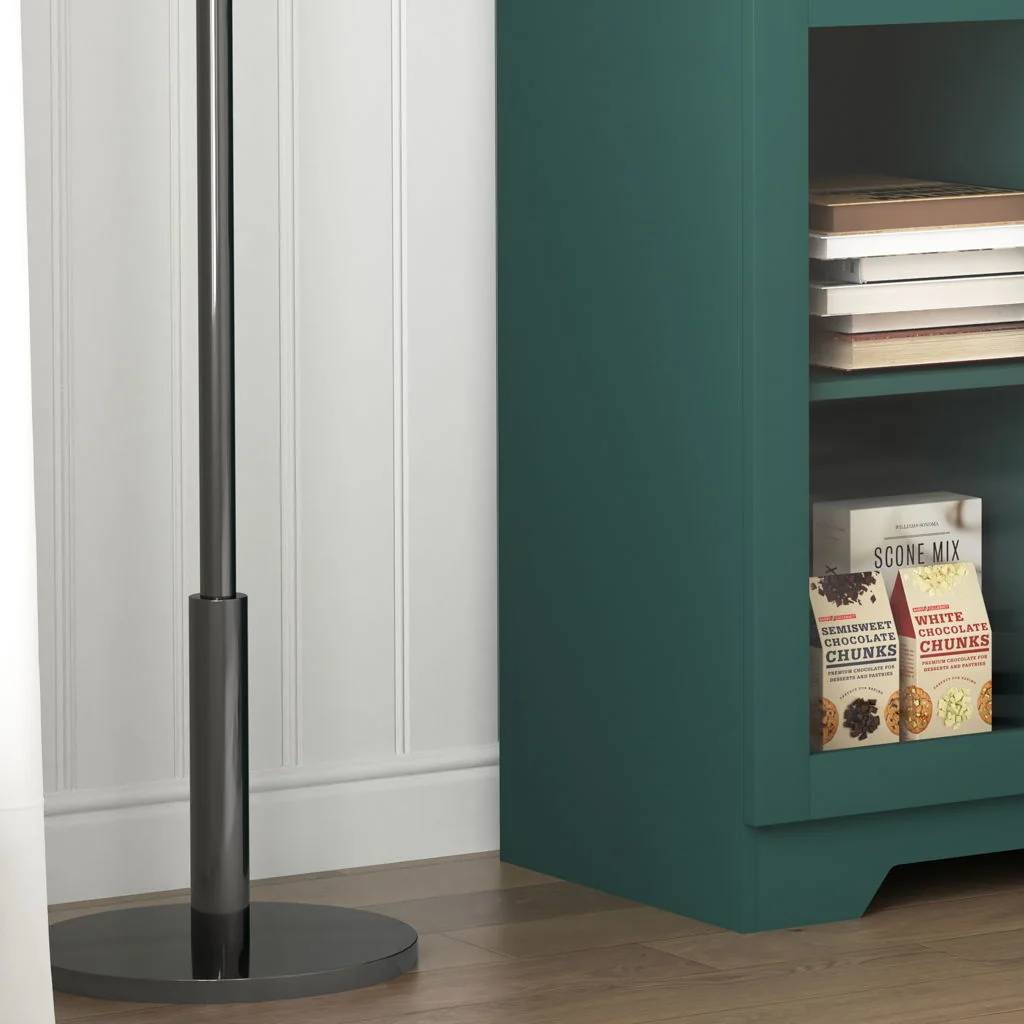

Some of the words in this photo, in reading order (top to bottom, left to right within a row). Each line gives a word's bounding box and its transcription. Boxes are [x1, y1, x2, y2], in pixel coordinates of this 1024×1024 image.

[874, 543, 925, 568] SCONE
[933, 540, 960, 563] MIX
[915, 612, 964, 626] WHITE
[821, 620, 892, 636] SEMISWEET
[918, 622, 989, 637] CHOCOLATE
[824, 632, 896, 647] CHOCOLATE
[920, 634, 990, 653] CHUNKS
[826, 644, 897, 663] CHUNKS
[946, 656, 976, 664] CHOCOLATE
[853, 666, 883, 674] CHOCOLATE
